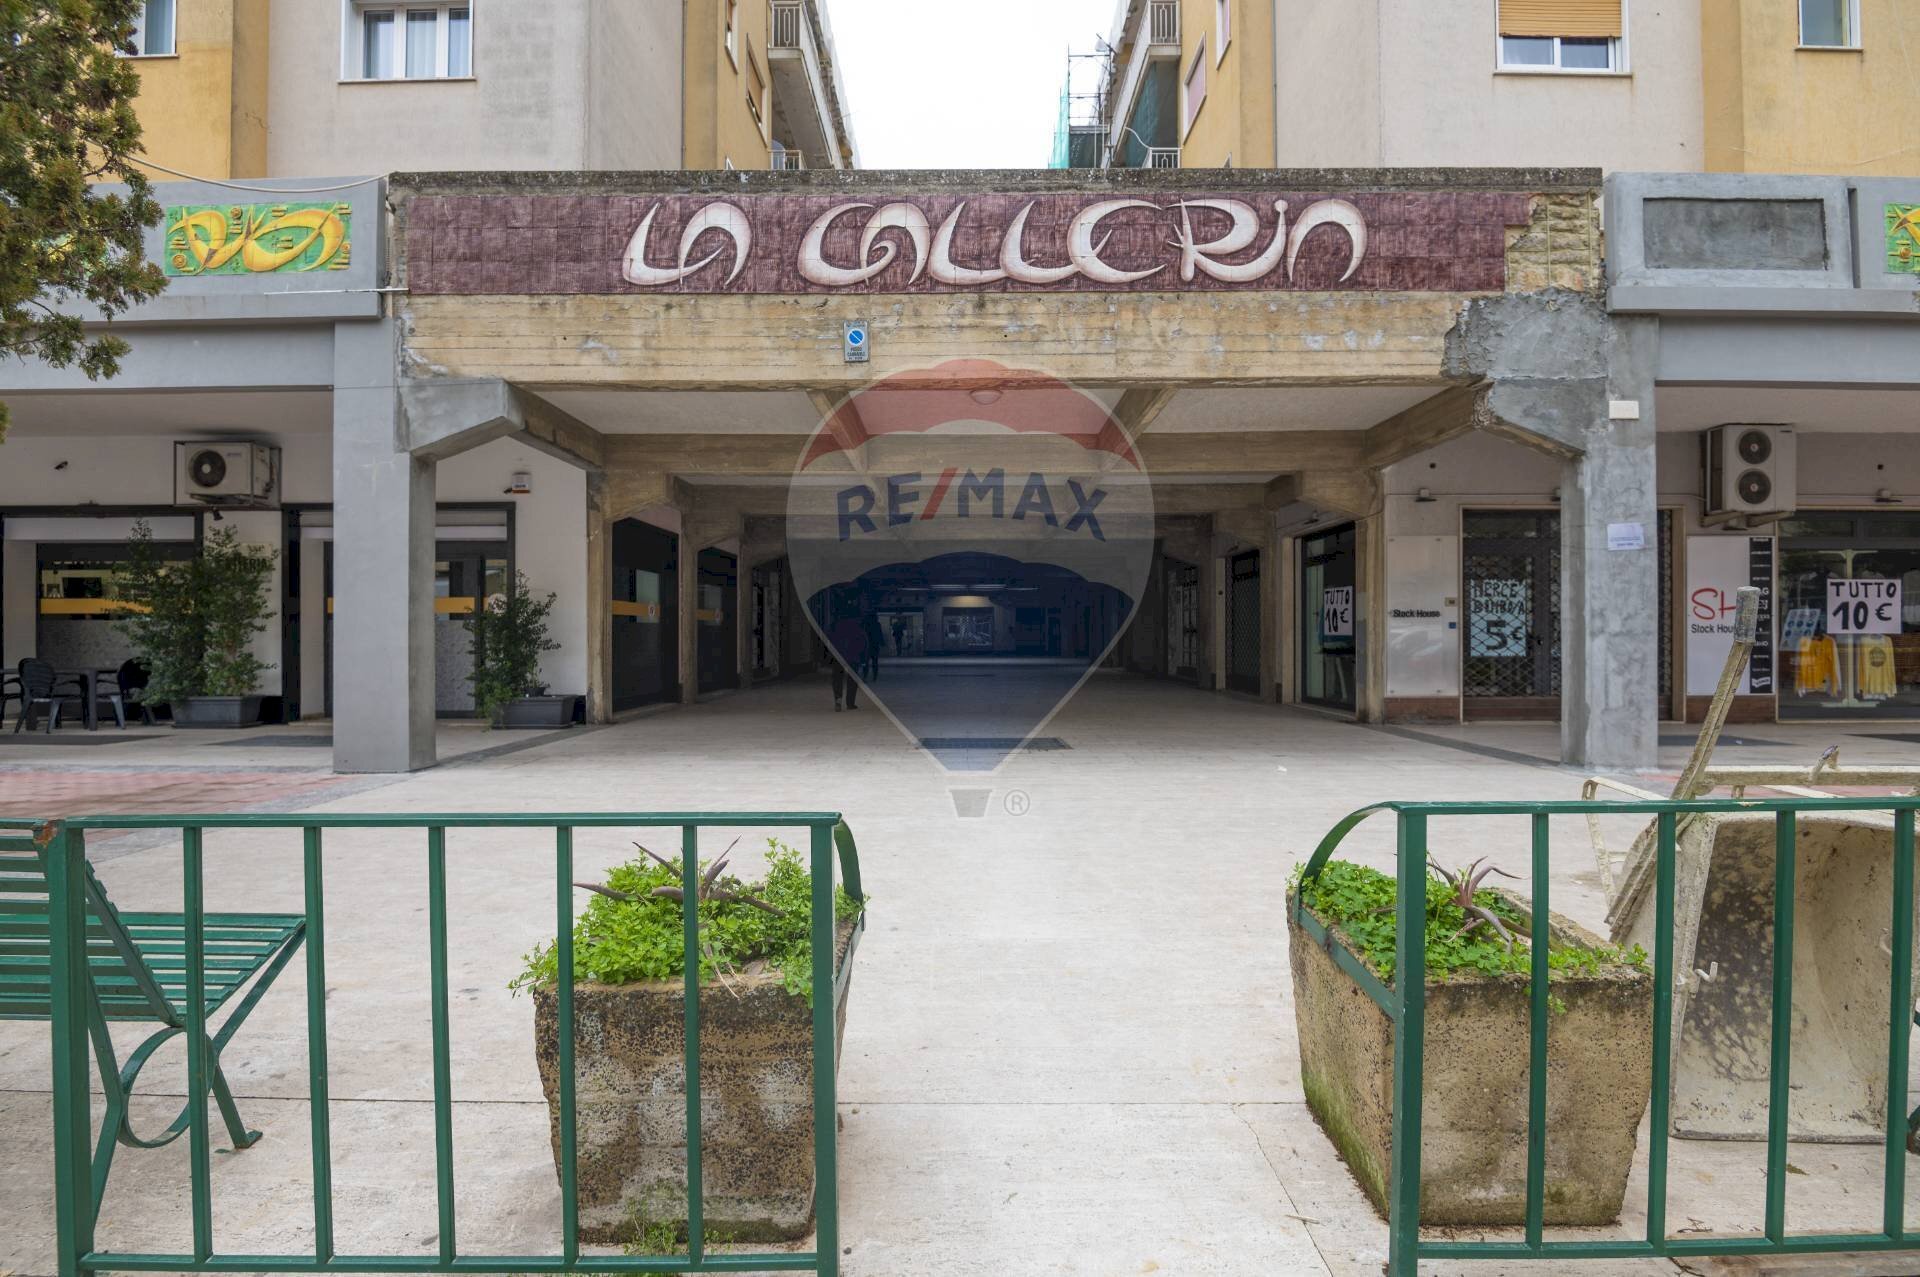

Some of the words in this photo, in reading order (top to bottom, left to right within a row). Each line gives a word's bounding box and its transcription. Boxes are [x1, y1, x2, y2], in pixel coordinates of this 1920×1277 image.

[622, 200, 753, 288] LA
[1325, 590, 1350, 605] TUTTO
[1830, 581, 1898, 598] TUTTO
[1325, 607, 1338, 633] 10
[1339, 608, 1349, 623] €
[1393, 608, 1415, 618] Stock
[1416, 608, 1441, 618] House
[1832, 601, 1869, 631] 10
[1875, 603, 1893, 621] €
[1486, 619, 1508, 651] 5
[1691, 623, 1715, 634] Stock
